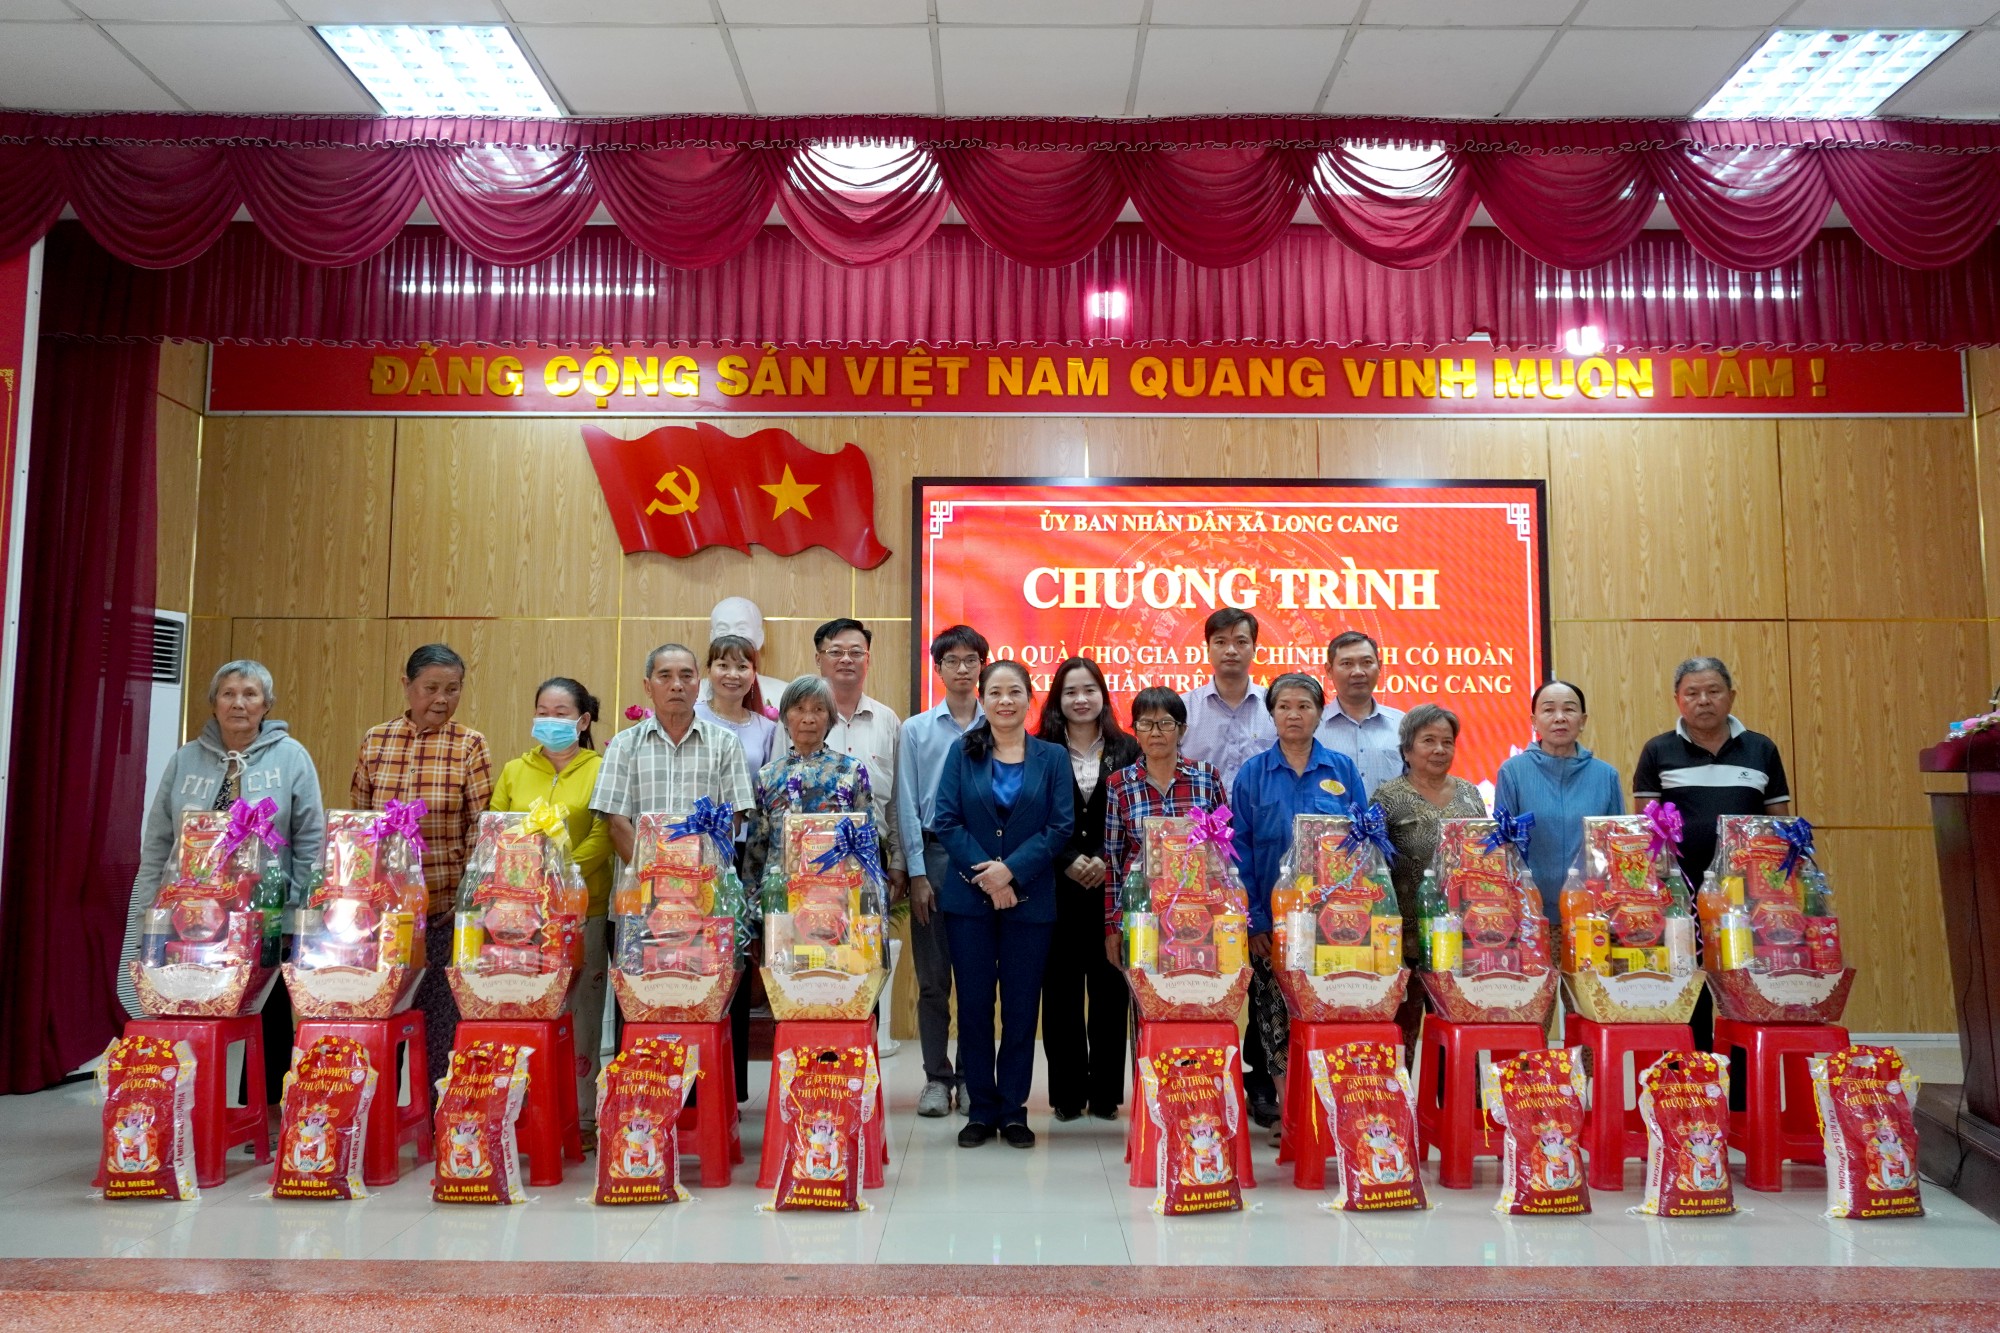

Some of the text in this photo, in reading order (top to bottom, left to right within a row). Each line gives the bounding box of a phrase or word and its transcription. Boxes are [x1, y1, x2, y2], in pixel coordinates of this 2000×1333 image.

[370, 343, 523, 396] ĐẢNG
[544, 346, 699, 408] CỘNG
[716, 343, 826, 396] SẢN
[844, 347, 969, 407] VIỆT
[987, 357, 1109, 396] NAM
[1129, 357, 1326, 400] QUANG
[1342, 358, 1478, 397] VINH
[1671, 349, 1795, 397] NĂM
[1039, 509, 1399, 532] ỦY BAN NHÂN DÂN XÃ LONG CANG
[1023, 556, 1441, 610] CHƯƠNG TRÌNH
[1021, 640, 1070, 667] QUÀ
[1078, 645, 1130, 664] CHO
[1136, 646, 1180, 665] GIA
[1185, 642, 1211, 665] ĐÌ
[1252, 641, 1329, 665] CHÍNH
[1405, 641, 1440, 665] CÓ
[1446, 641, 1514, 665] HOÀN
[1103, 669, 1155, 692] HĂN
[1160, 668, 1214, 692] TRÊ
[1444, 674, 1512, 693] CANG
[1199, 1088, 1220, 1100] HẠN
[1660, 1097, 1692, 1109] THƯỢG
[1652, 1147, 1662, 1187] AMPUCHIA
[127, 1179, 155, 1187] MIÊN
[301, 1179, 328, 1187] MIÊN
[106, 1188, 167, 1197] CAMPUCHIA
[277, 1187, 339, 1196] CAMPUCHIA
[461, 1185, 489, 1193] MIÊN
[632, 1184, 660, 1193] MIÊN
[813, 1187, 841, 1197] MIÊN
[1384, 1188, 1411, 1199] MIÊN
[437, 1194, 499, 1202] CAMPUCHIA
[603, 1193, 668, 1203] CAMPUCHIA
[1203, 1189, 1229, 1200] MIÊN
[784, 1196, 849, 1208] CAMPUCHIA
[1356, 1197, 1419, 1210] CAMPUCHIA
[1554, 1195, 1579, 1205] MIÊN
[1701, 1197, 1727, 1206] MIÊN
[1891, 1196, 1915, 1205] MIÊN
[1174, 1199, 1237, 1212] CAMPUCHIA
[1522, 1204, 1585, 1213] CAMPUCHIA
[1669, 1206, 1732, 1216] CAMPUCHIA
[1861, 1206, 1920, 1217] CAMPUCHIA
